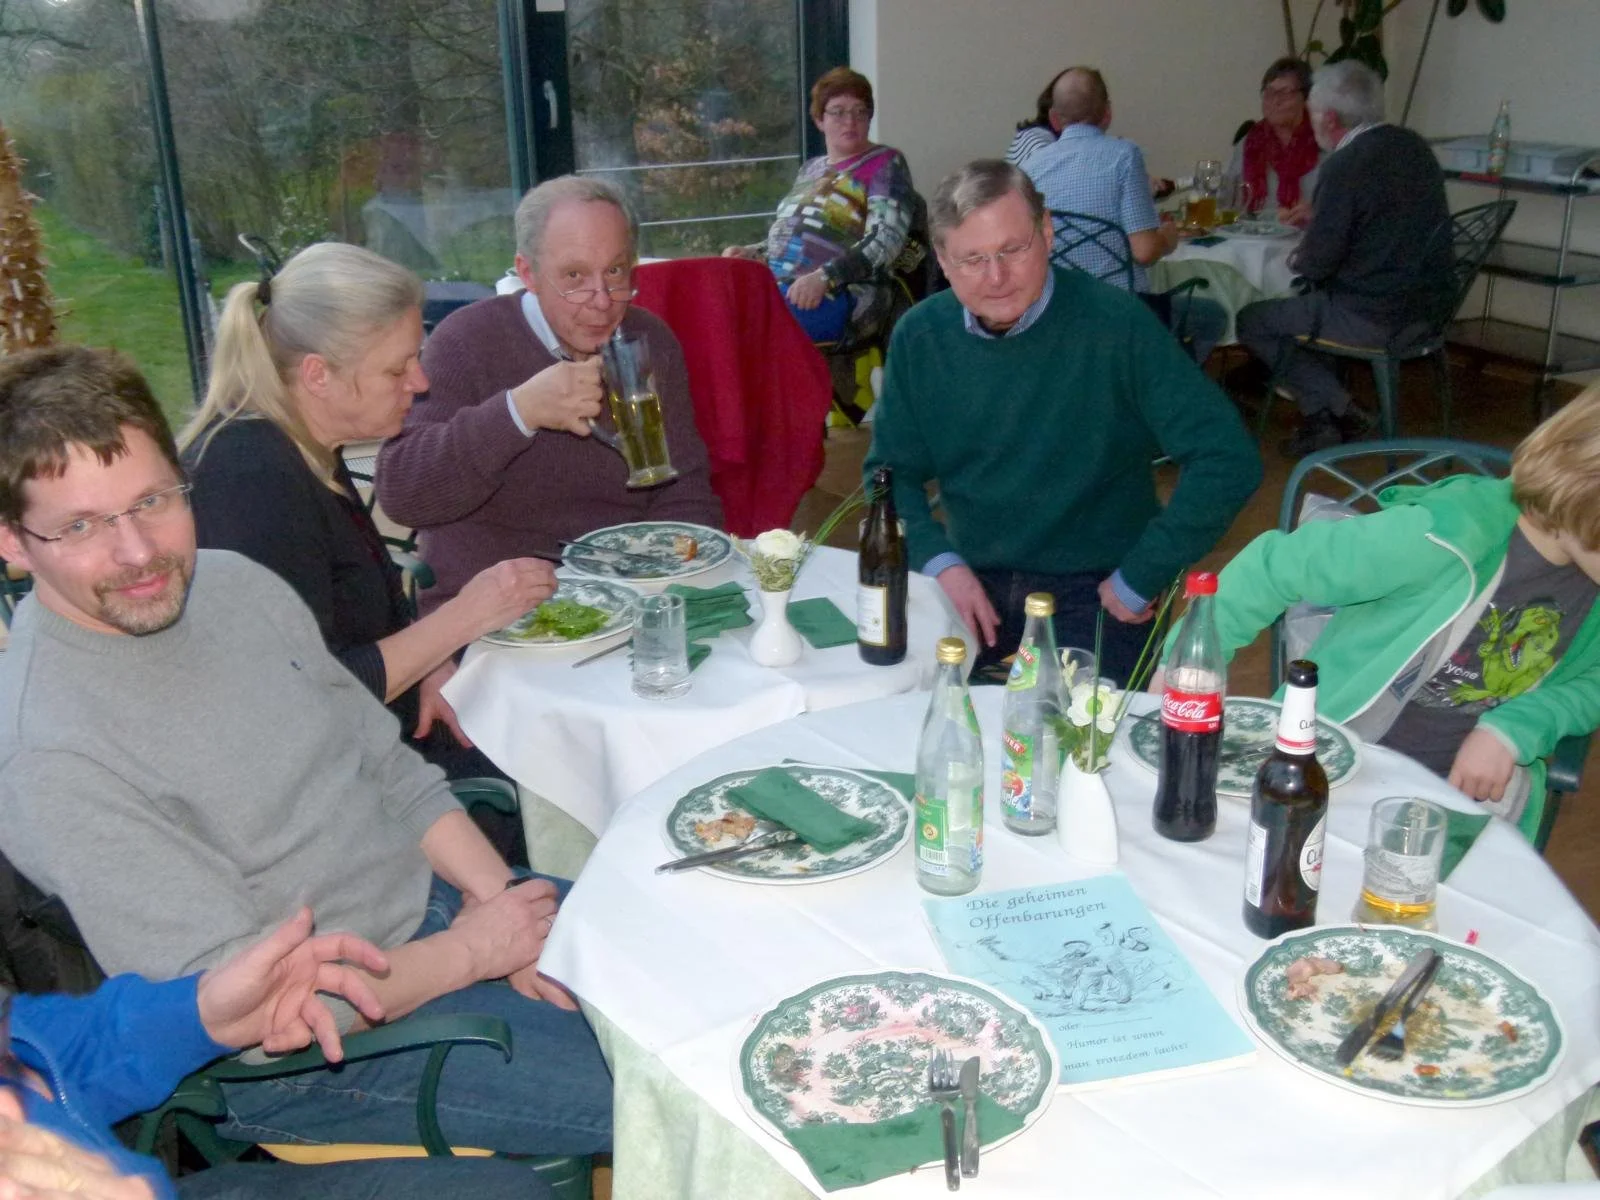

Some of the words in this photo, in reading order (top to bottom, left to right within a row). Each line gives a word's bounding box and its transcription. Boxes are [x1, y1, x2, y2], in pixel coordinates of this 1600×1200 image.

[966, 899, 1000, 911] Die
[1006, 887, 1088, 909] geheimen
[969, 901, 1107, 930] Offenbarungen
[1058, 1022, 1080, 1032] oder
[1066, 1037, 1109, 1049] Humor
[1064, 1061, 1090, 1071] man
[1095, 1050, 1151, 1065] trotzdem
